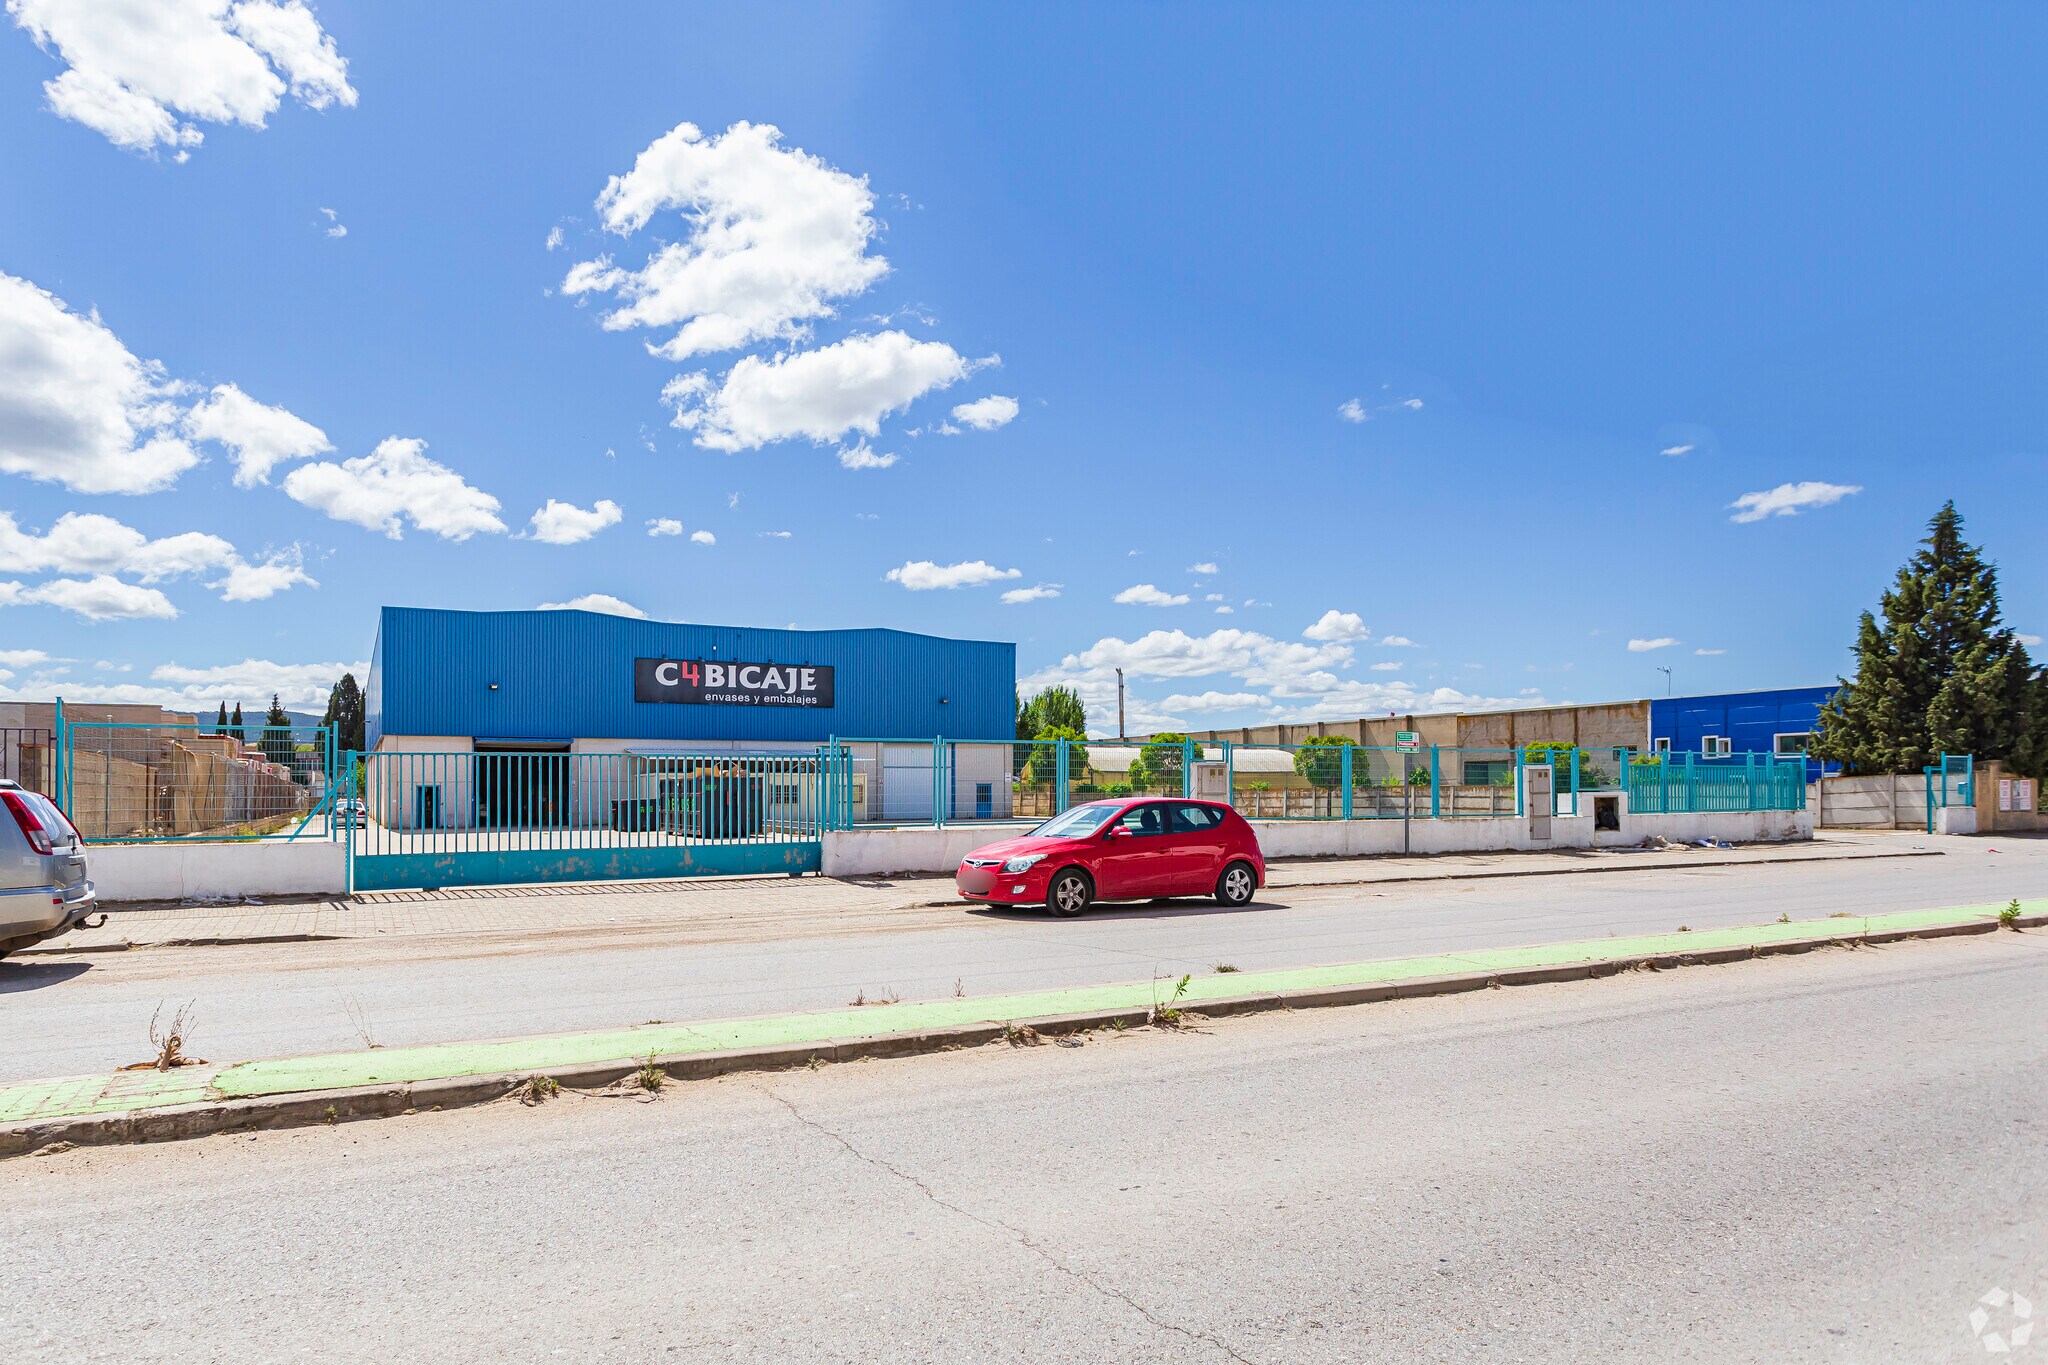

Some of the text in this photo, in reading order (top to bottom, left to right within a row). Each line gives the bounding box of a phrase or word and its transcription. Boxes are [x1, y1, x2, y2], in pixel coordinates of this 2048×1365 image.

[655, 661, 817, 694] C4BICAJE
[705, 693, 817, 705] envases y embalajes
